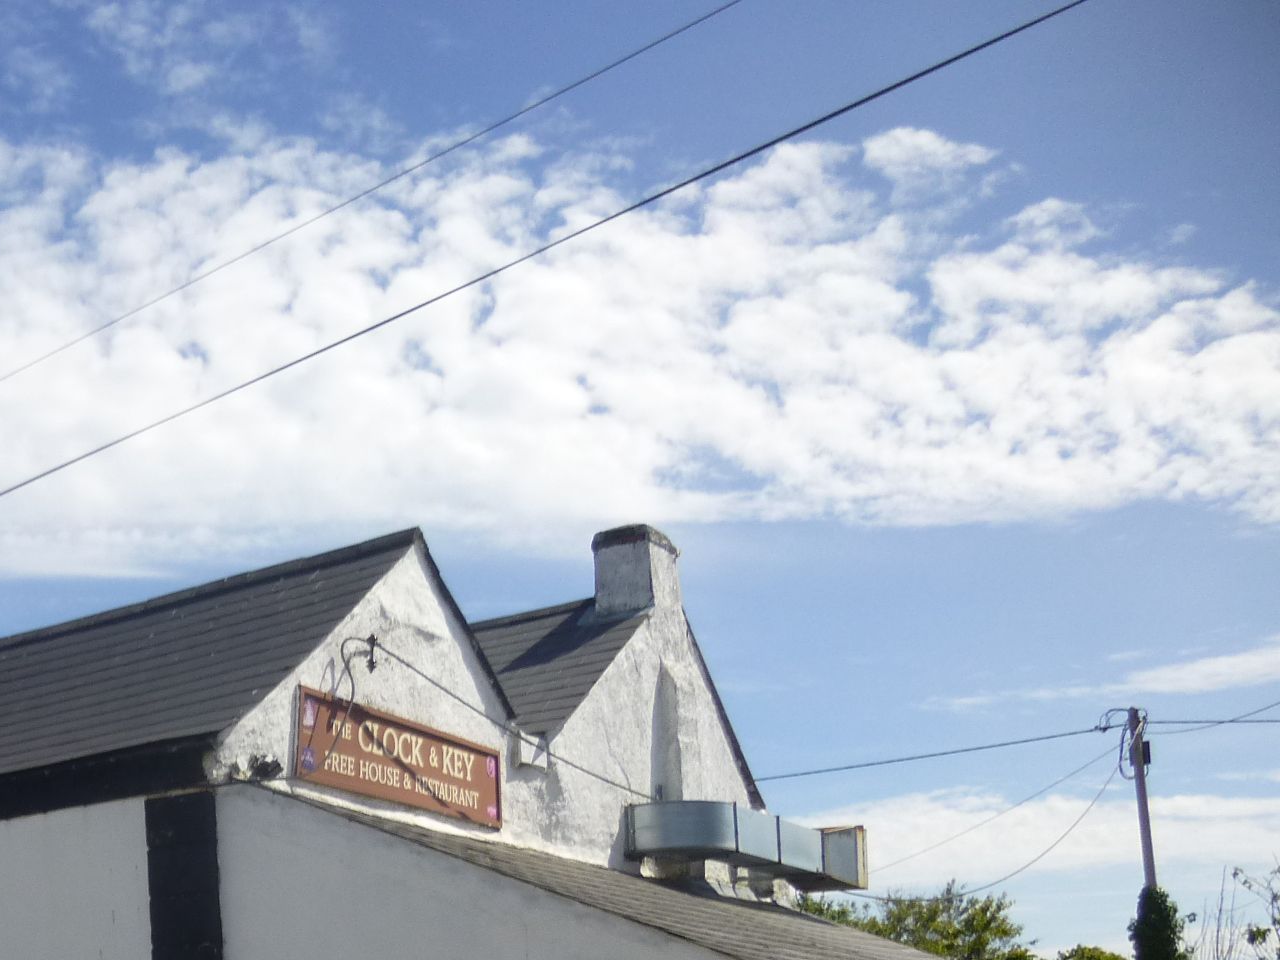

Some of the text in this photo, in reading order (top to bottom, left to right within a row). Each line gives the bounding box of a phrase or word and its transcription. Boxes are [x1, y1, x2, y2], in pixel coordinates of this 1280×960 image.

[324, 750, 479, 810] FREE HOUSE & RESTAURANT
[332, 719, 475, 781] THE CLOCK & KEY
